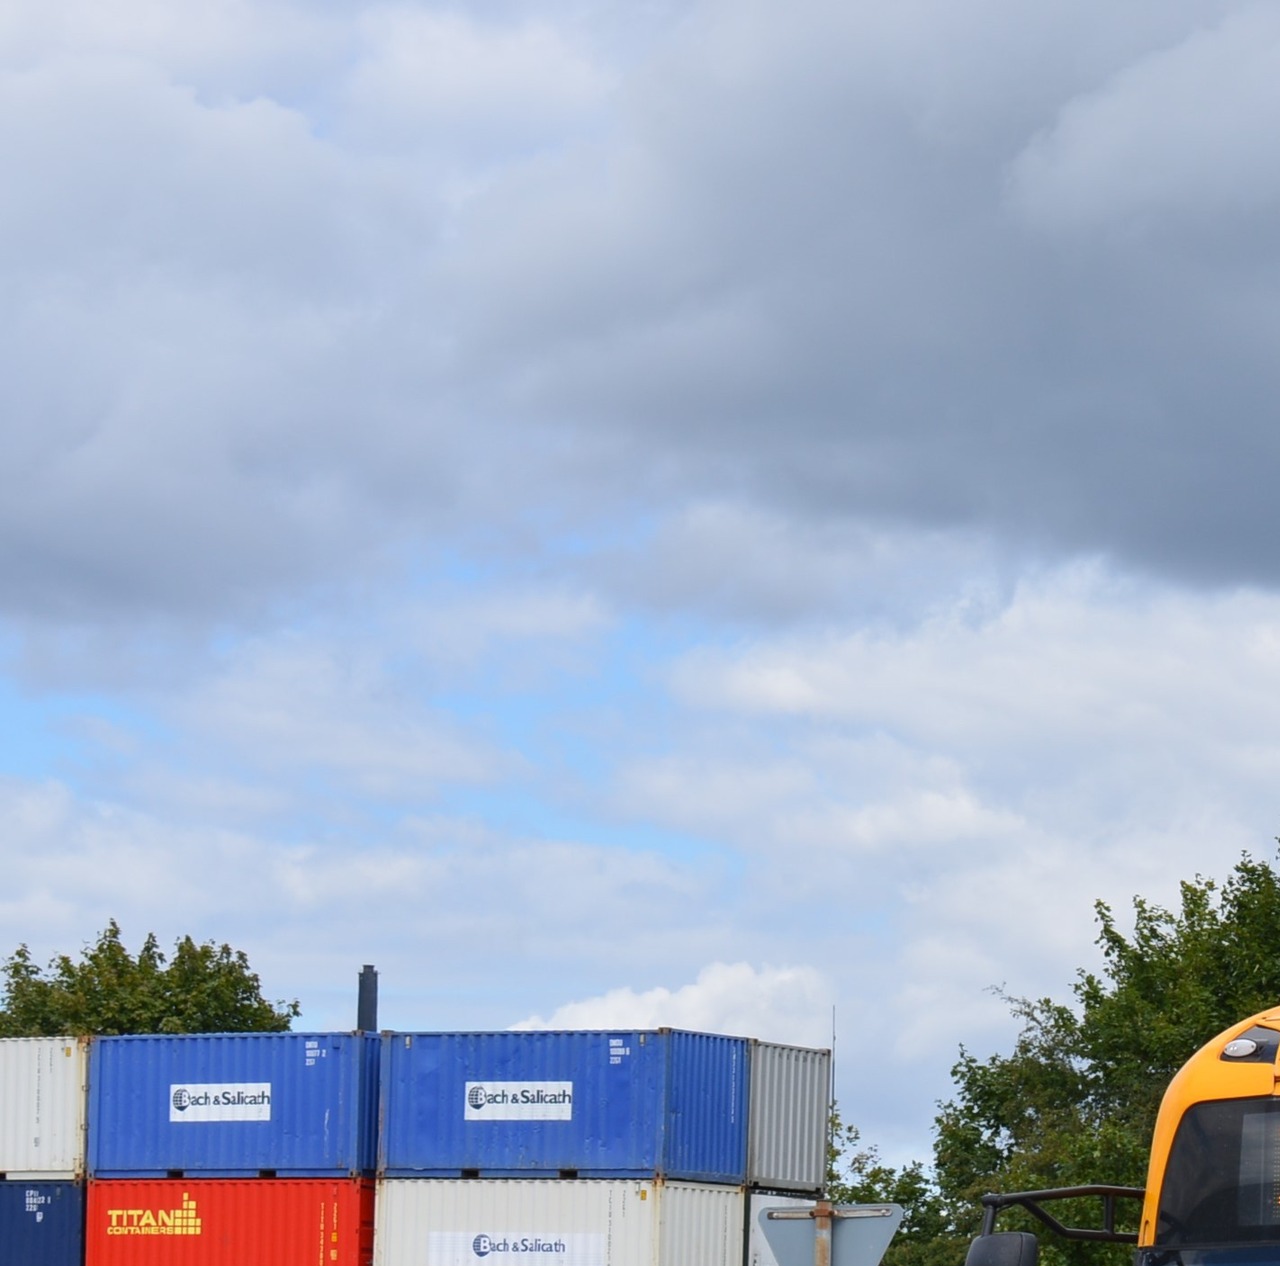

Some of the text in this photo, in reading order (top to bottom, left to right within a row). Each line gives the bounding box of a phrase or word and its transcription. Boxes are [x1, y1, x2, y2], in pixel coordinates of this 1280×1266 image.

[177, 1089, 270, 1108] Bach & Salicath
[472, 1087, 572, 1106] Bach & Salicath
[107, 1210, 174, 1226] TITAN
[107, 1226, 174, 1235] CONTAINERS
[477, 1236, 566, 1254] Bach & Salicath
